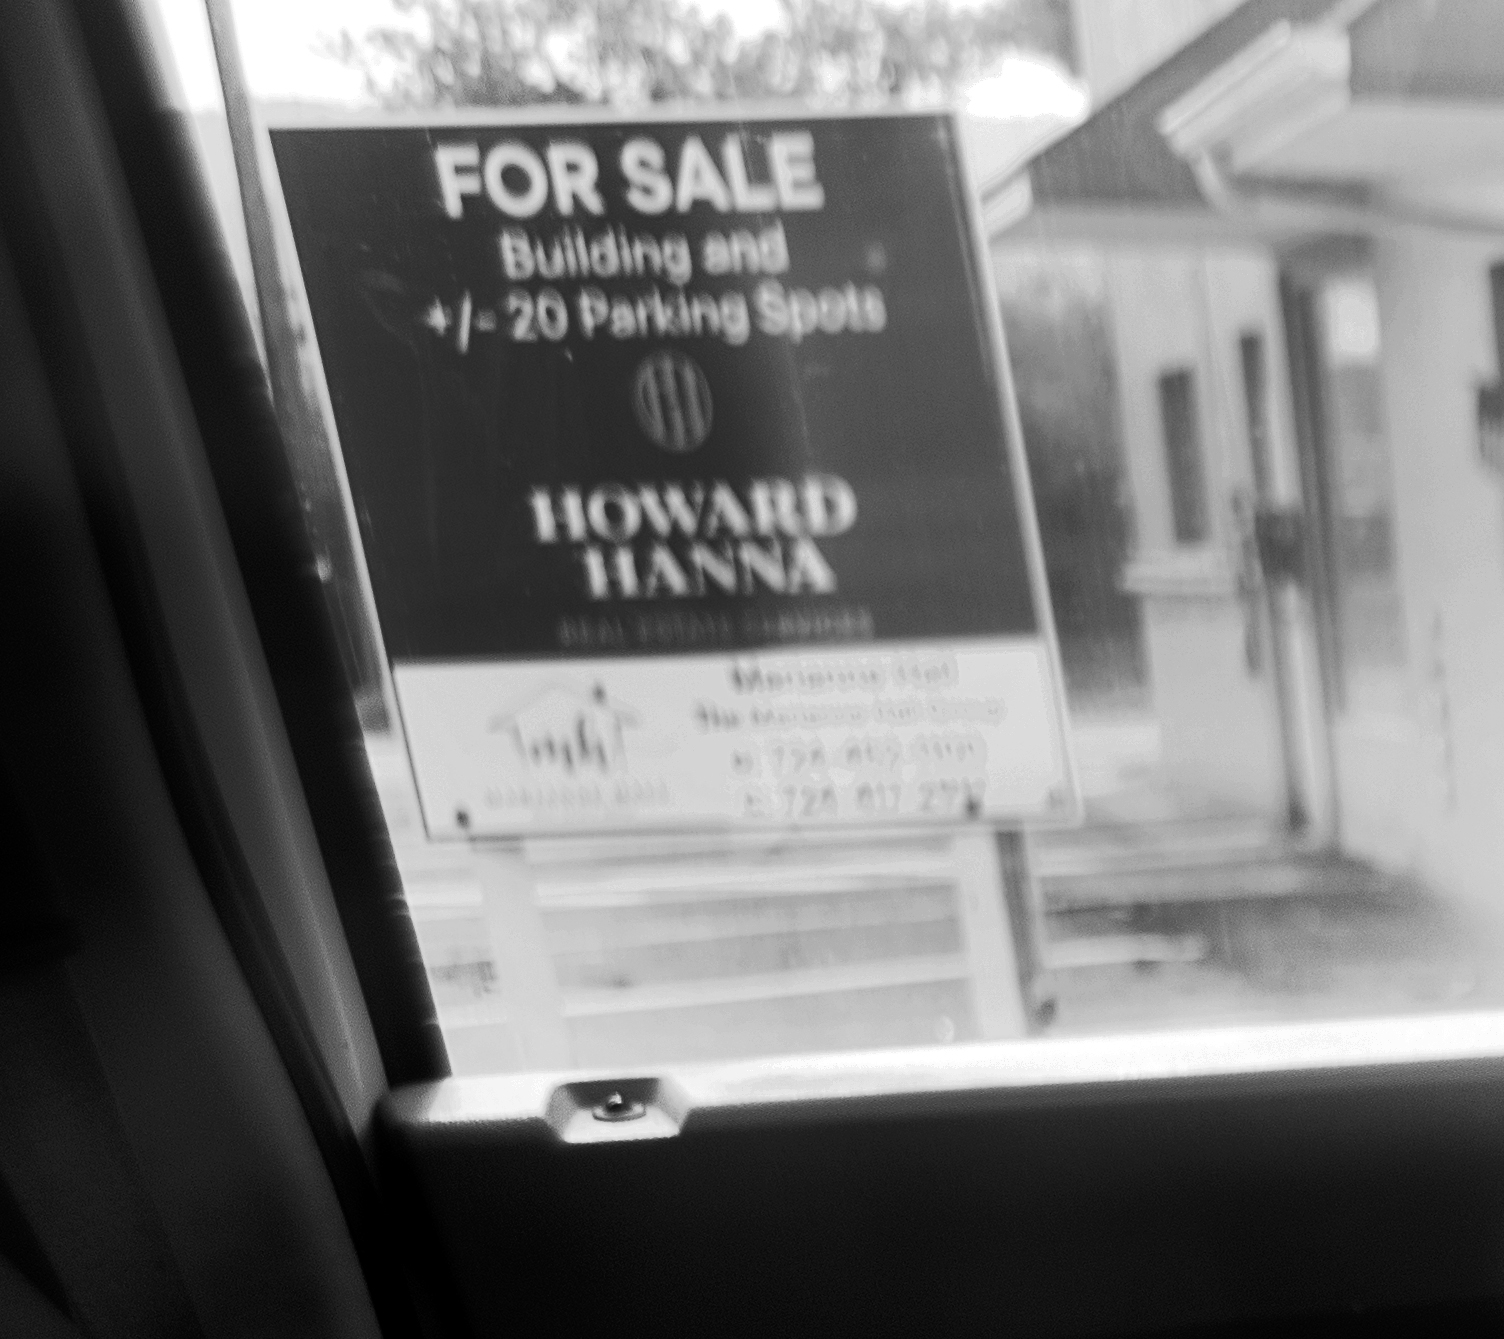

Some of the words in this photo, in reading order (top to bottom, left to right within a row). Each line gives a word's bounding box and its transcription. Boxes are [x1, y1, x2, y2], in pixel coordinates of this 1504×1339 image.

[434, 138, 606, 219] FOR
[619, 129, 826, 214] SALE
[500, 221, 693, 287] Building
[703, 216, 791, 276] and
[506, 285, 568, 343] 20
[579, 283, 752, 346] Parking
[755, 276, 888, 344] Spots
[529, 472, 858, 544] HOWARD
[584, 535, 837, 598] HANNA
